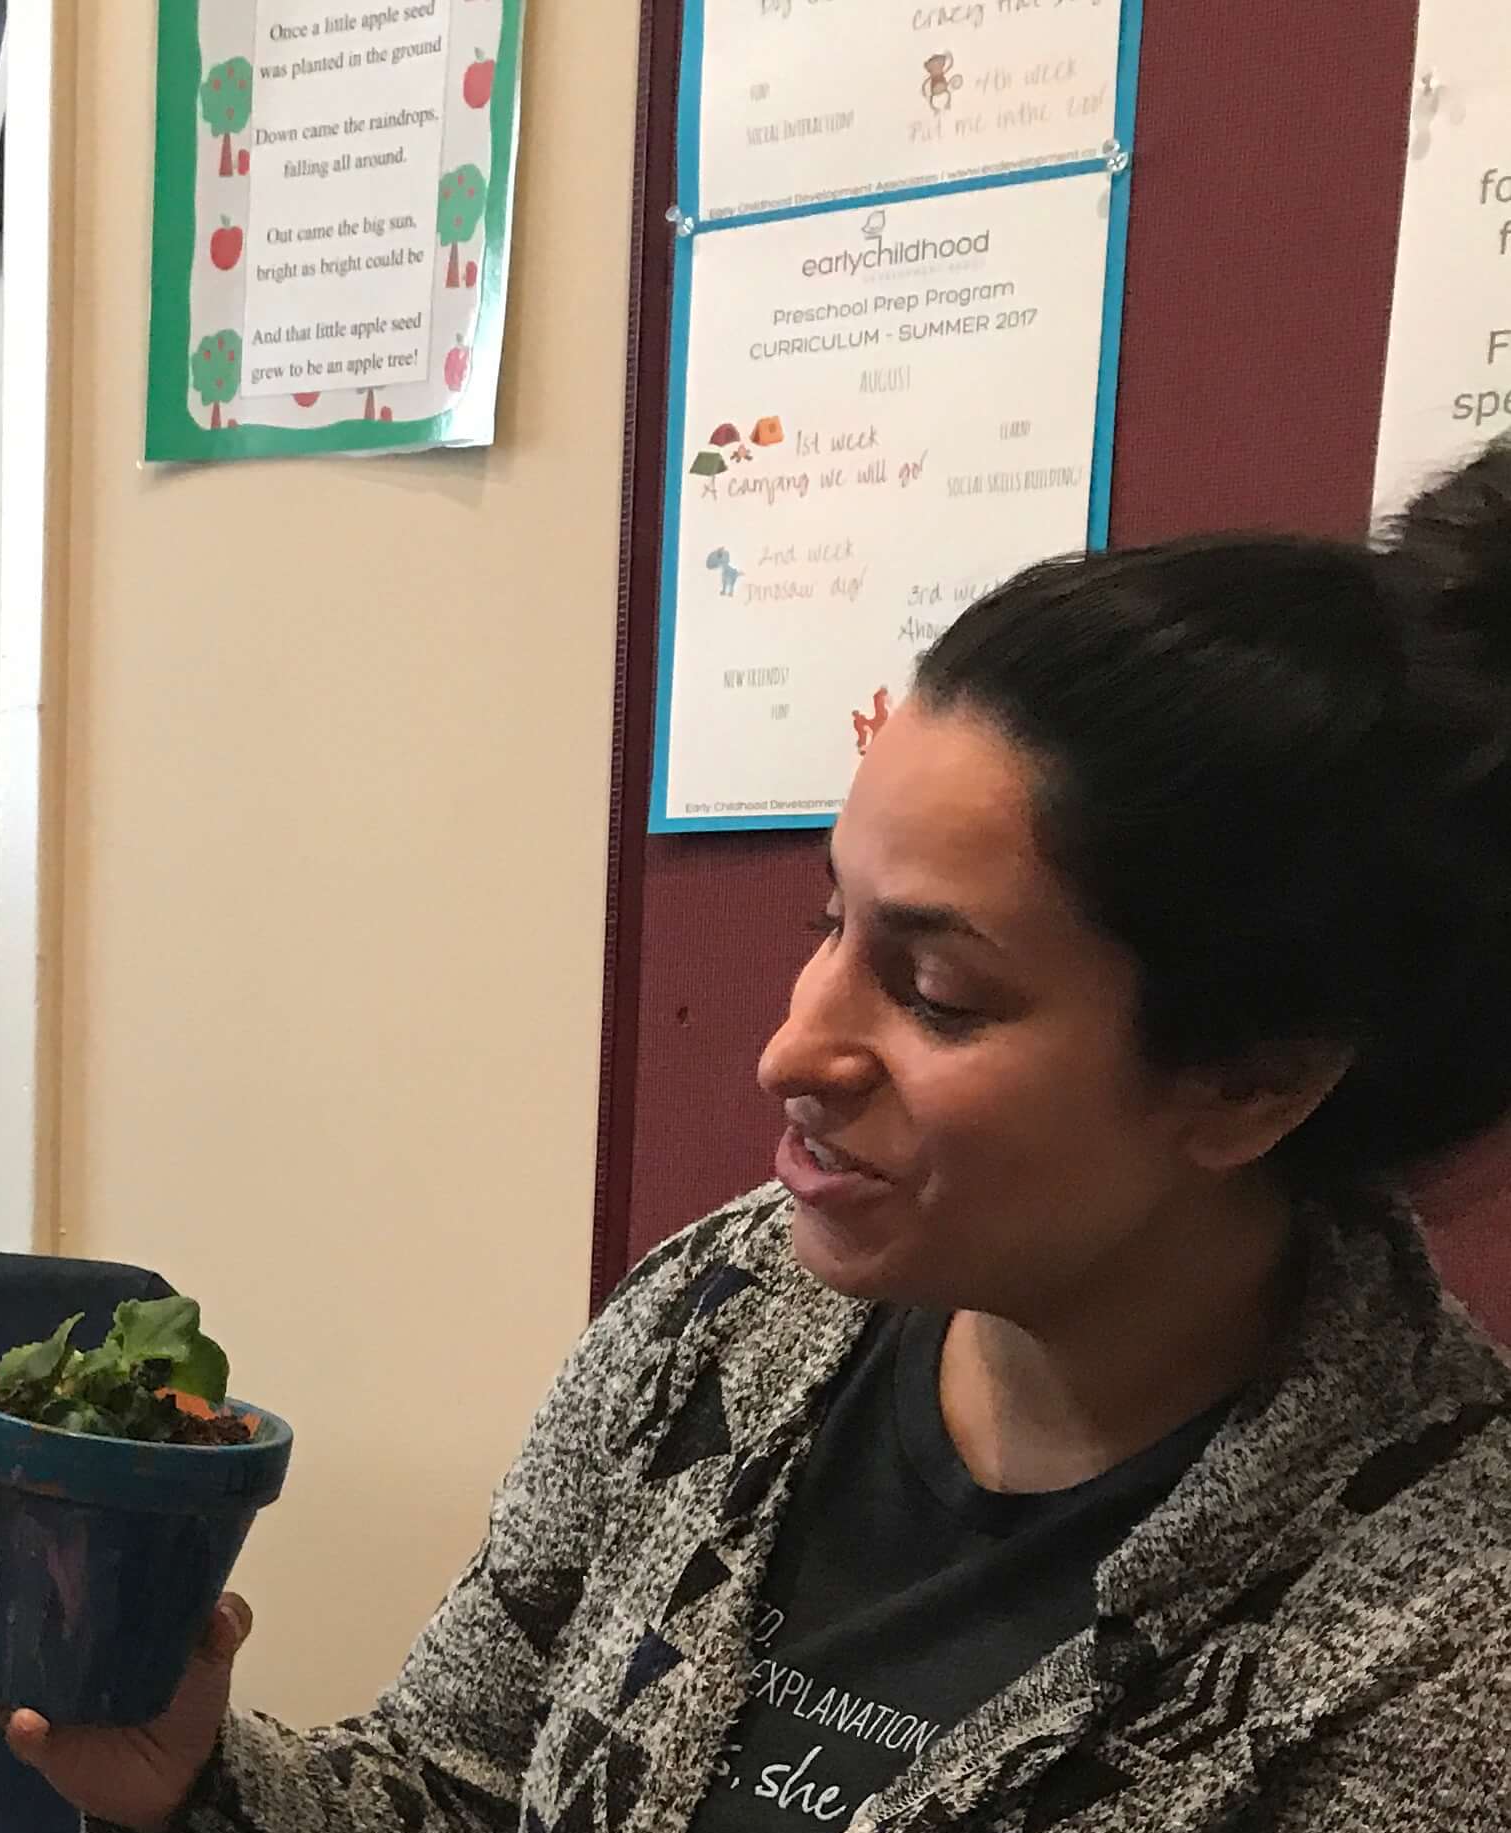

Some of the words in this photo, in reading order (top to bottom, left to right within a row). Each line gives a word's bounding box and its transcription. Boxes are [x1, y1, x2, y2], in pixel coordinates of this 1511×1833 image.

[270, 23, 307, 41] Once
[311, 26, 320, 36] a
[324, 13, 356, 34] little
[361, 7, 399, 31] apple
[403, 1, 435, 20] seed
[260, 64, 287, 79] was
[291, 52, 344, 80] planted
[348, 53, 362, 68] in
[366, 47, 387, 64] the
[391, 36, 442, 65] ground
[255, 128, 298, 145] Down
[302, 122, 339, 140] came
[344, 116, 365, 134] the
[283, 159, 328, 178] falling
[333, 154, 350, 172] all
[355, 146, 407, 169] around.
[267, 227, 292, 244] Out
[297, 225, 333, 242] came
[338, 219, 359, 237] the
[363, 216, 385, 237] big
[257, 264, 297, 283] bright
[301, 264, 316, 277] as
[321, 256, 362, 277] bright
[366, 248, 404, 269] could
[407, 248, 424, 265] be
[801, 229, 990, 278] earlychildhood
[774, 299, 868, 326] Preschool
[874, 293, 919, 313] Prep
[925, 281, 1015, 306] Program
[252, 326, 281, 345] And
[285, 324, 311, 343] that
[316, 321, 346, 340] little
[350, 316, 387, 339] apple
[391, 311, 422, 330] seed
[749, 329, 880, 360] CURRICULUM
[898, 315, 990, 342] SUMMER
[995, 308, 1038, 331] 2017
[251, 364, 284, 384] grew
[290, 362, 302, 377] to
[307, 359, 322, 376] be
[327, 360, 343, 374] an
[347, 352, 383, 376] apple
[388, 348, 418, 368] tree!
[859, 364, 911, 394] AUGUST
[796, 430, 820, 455] 1st
[831, 425, 880, 452] week
[820, 469, 843, 488] we
[858, 459, 886, 484] will
[808, 538, 853, 562] week
[907, 582, 942, 605] 3rd
[685, 802, 711, 815] Early
[714, 799, 768, 812] Childhood
[770, 797, 845, 811] Development
[754, 1744, 848, 1821] she
